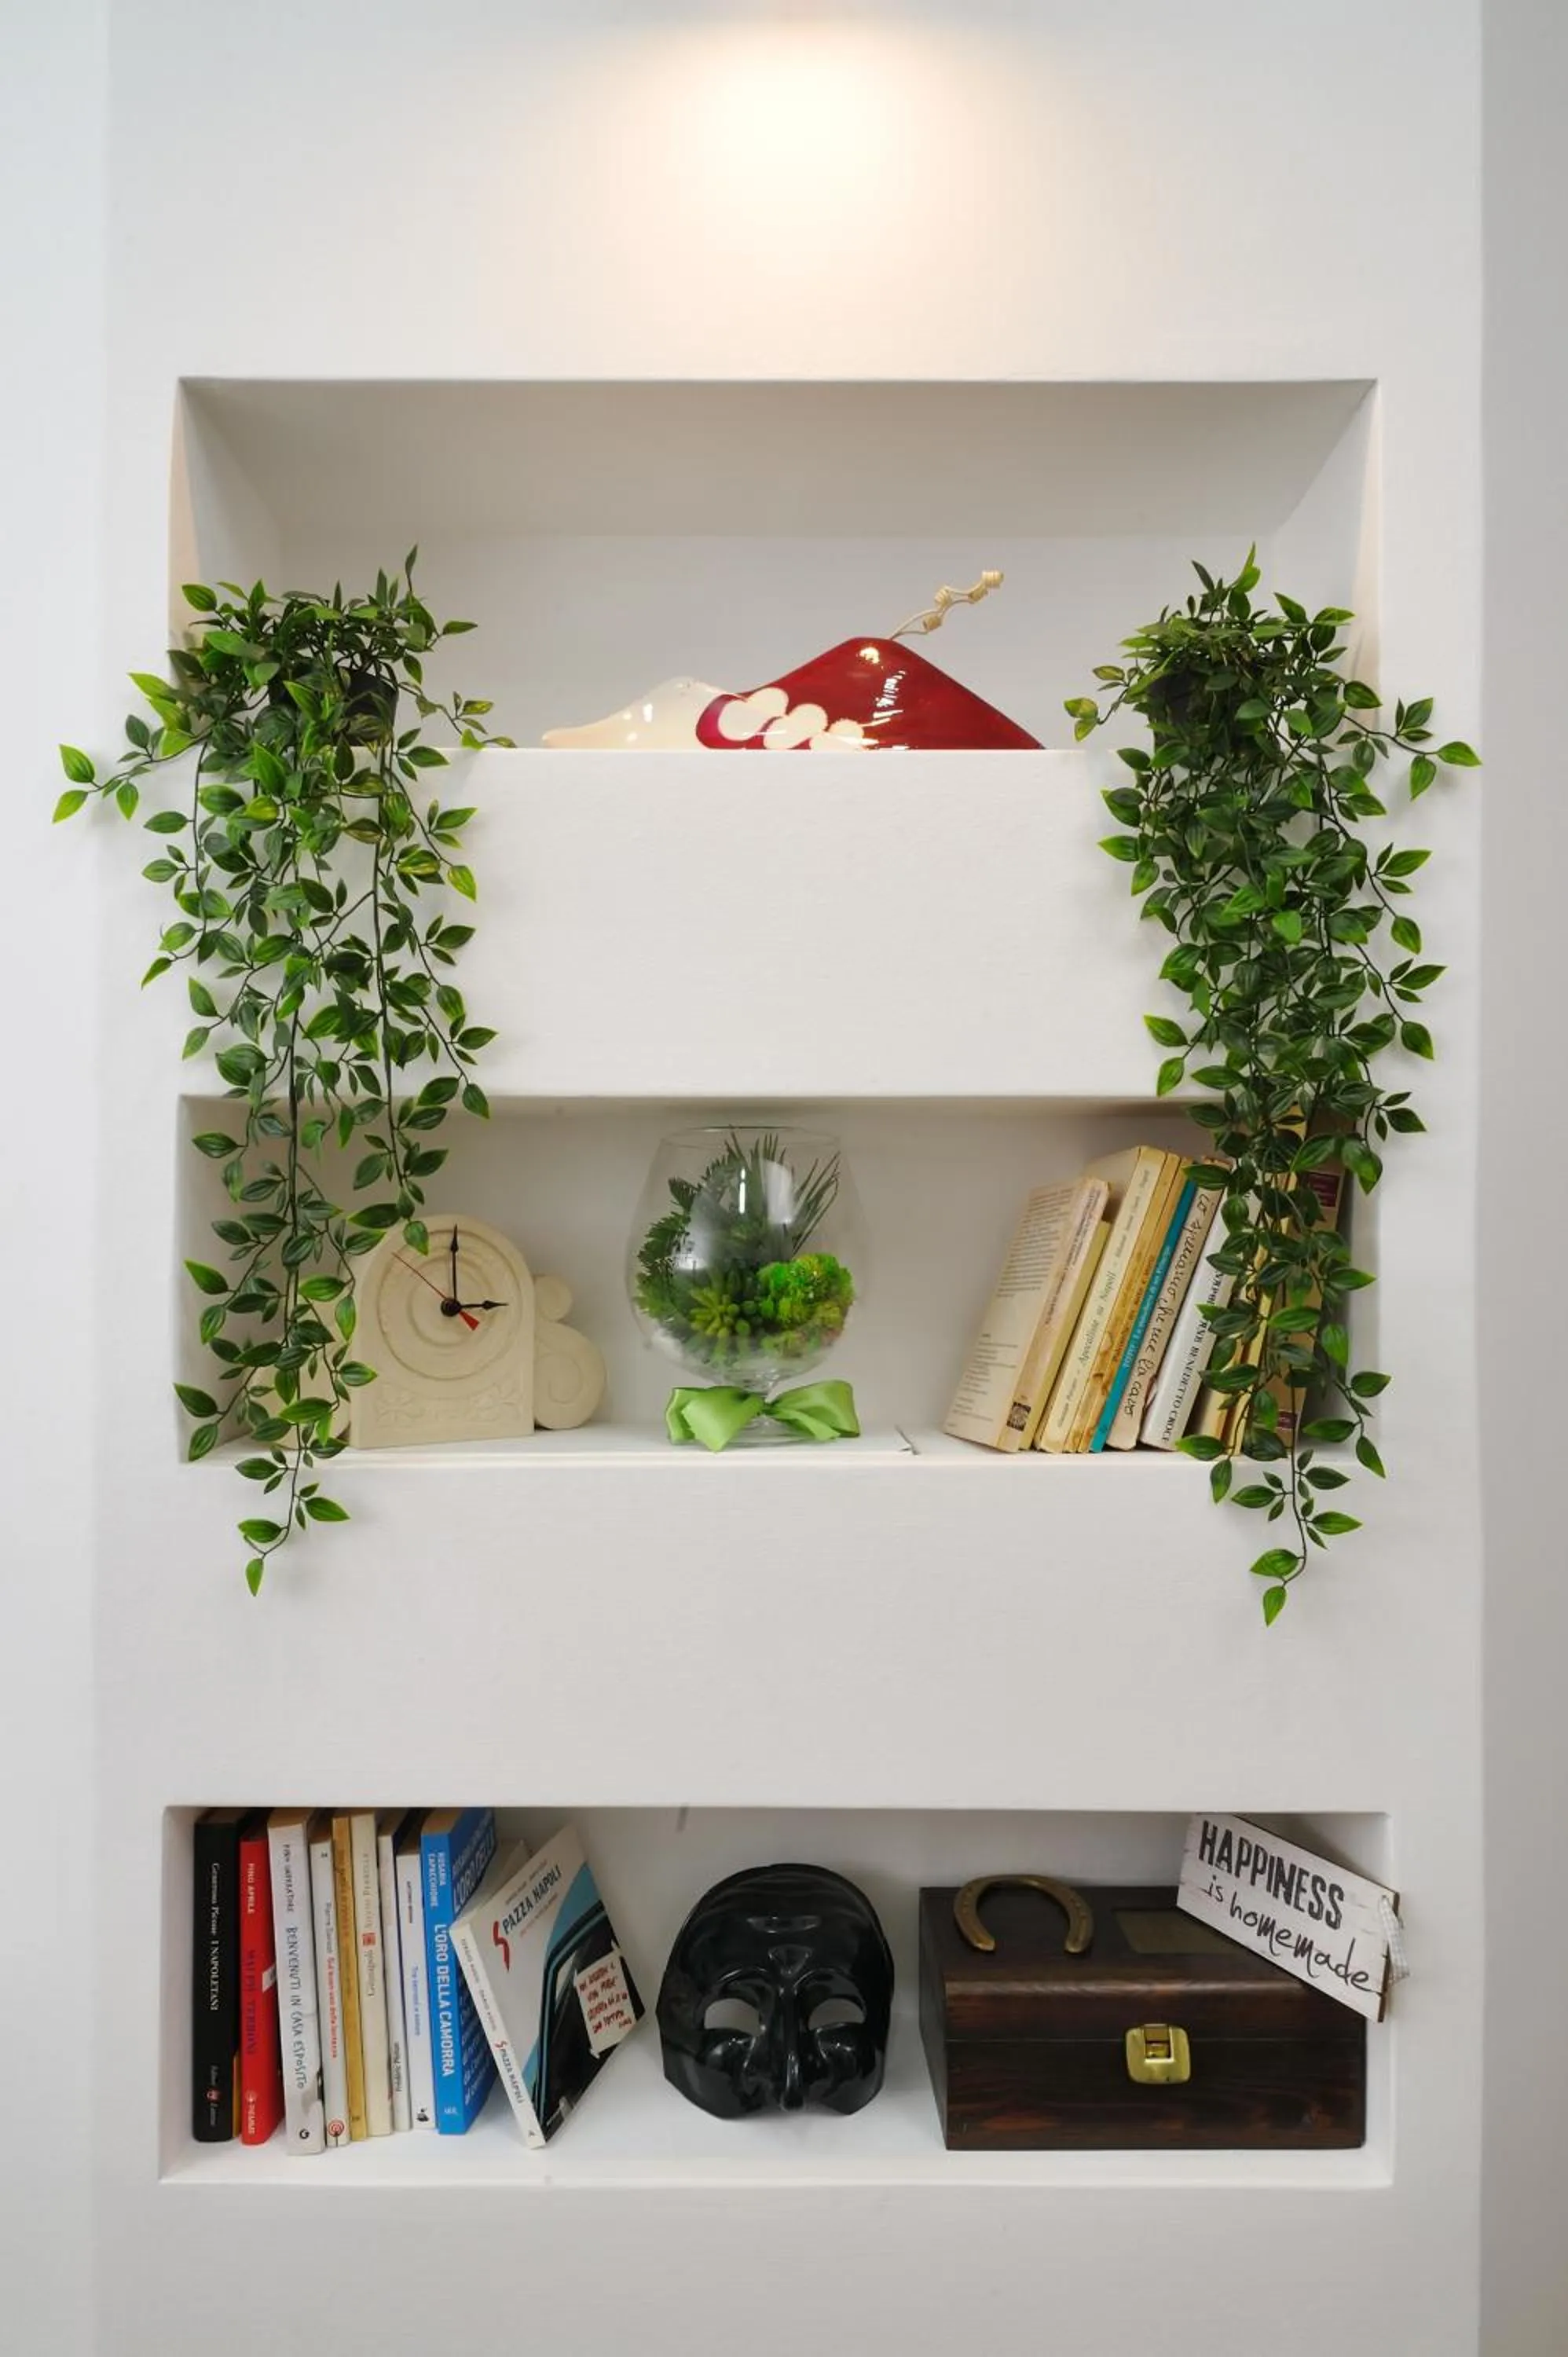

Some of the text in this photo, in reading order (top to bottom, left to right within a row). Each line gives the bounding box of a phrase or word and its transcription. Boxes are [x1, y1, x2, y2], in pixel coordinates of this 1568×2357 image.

[1161, 1345, 1200, 1442] BENEDETTO CROCE
[438, 1852, 446, 1886] ROSARIA
[531, 1863, 562, 1904] NAPOLI
[1198, 1820, 1345, 1930] HAPPINESS
[210, 1947, 220, 2011] NAPOLETANI
[1202, 1875, 1383, 1996] is homemade
[286, 1926, 306, 2089] BENVENUTI IN CASA ESPOSITO
[434, 1924, 455, 2077] L'ORO DELLA CAMORRA
